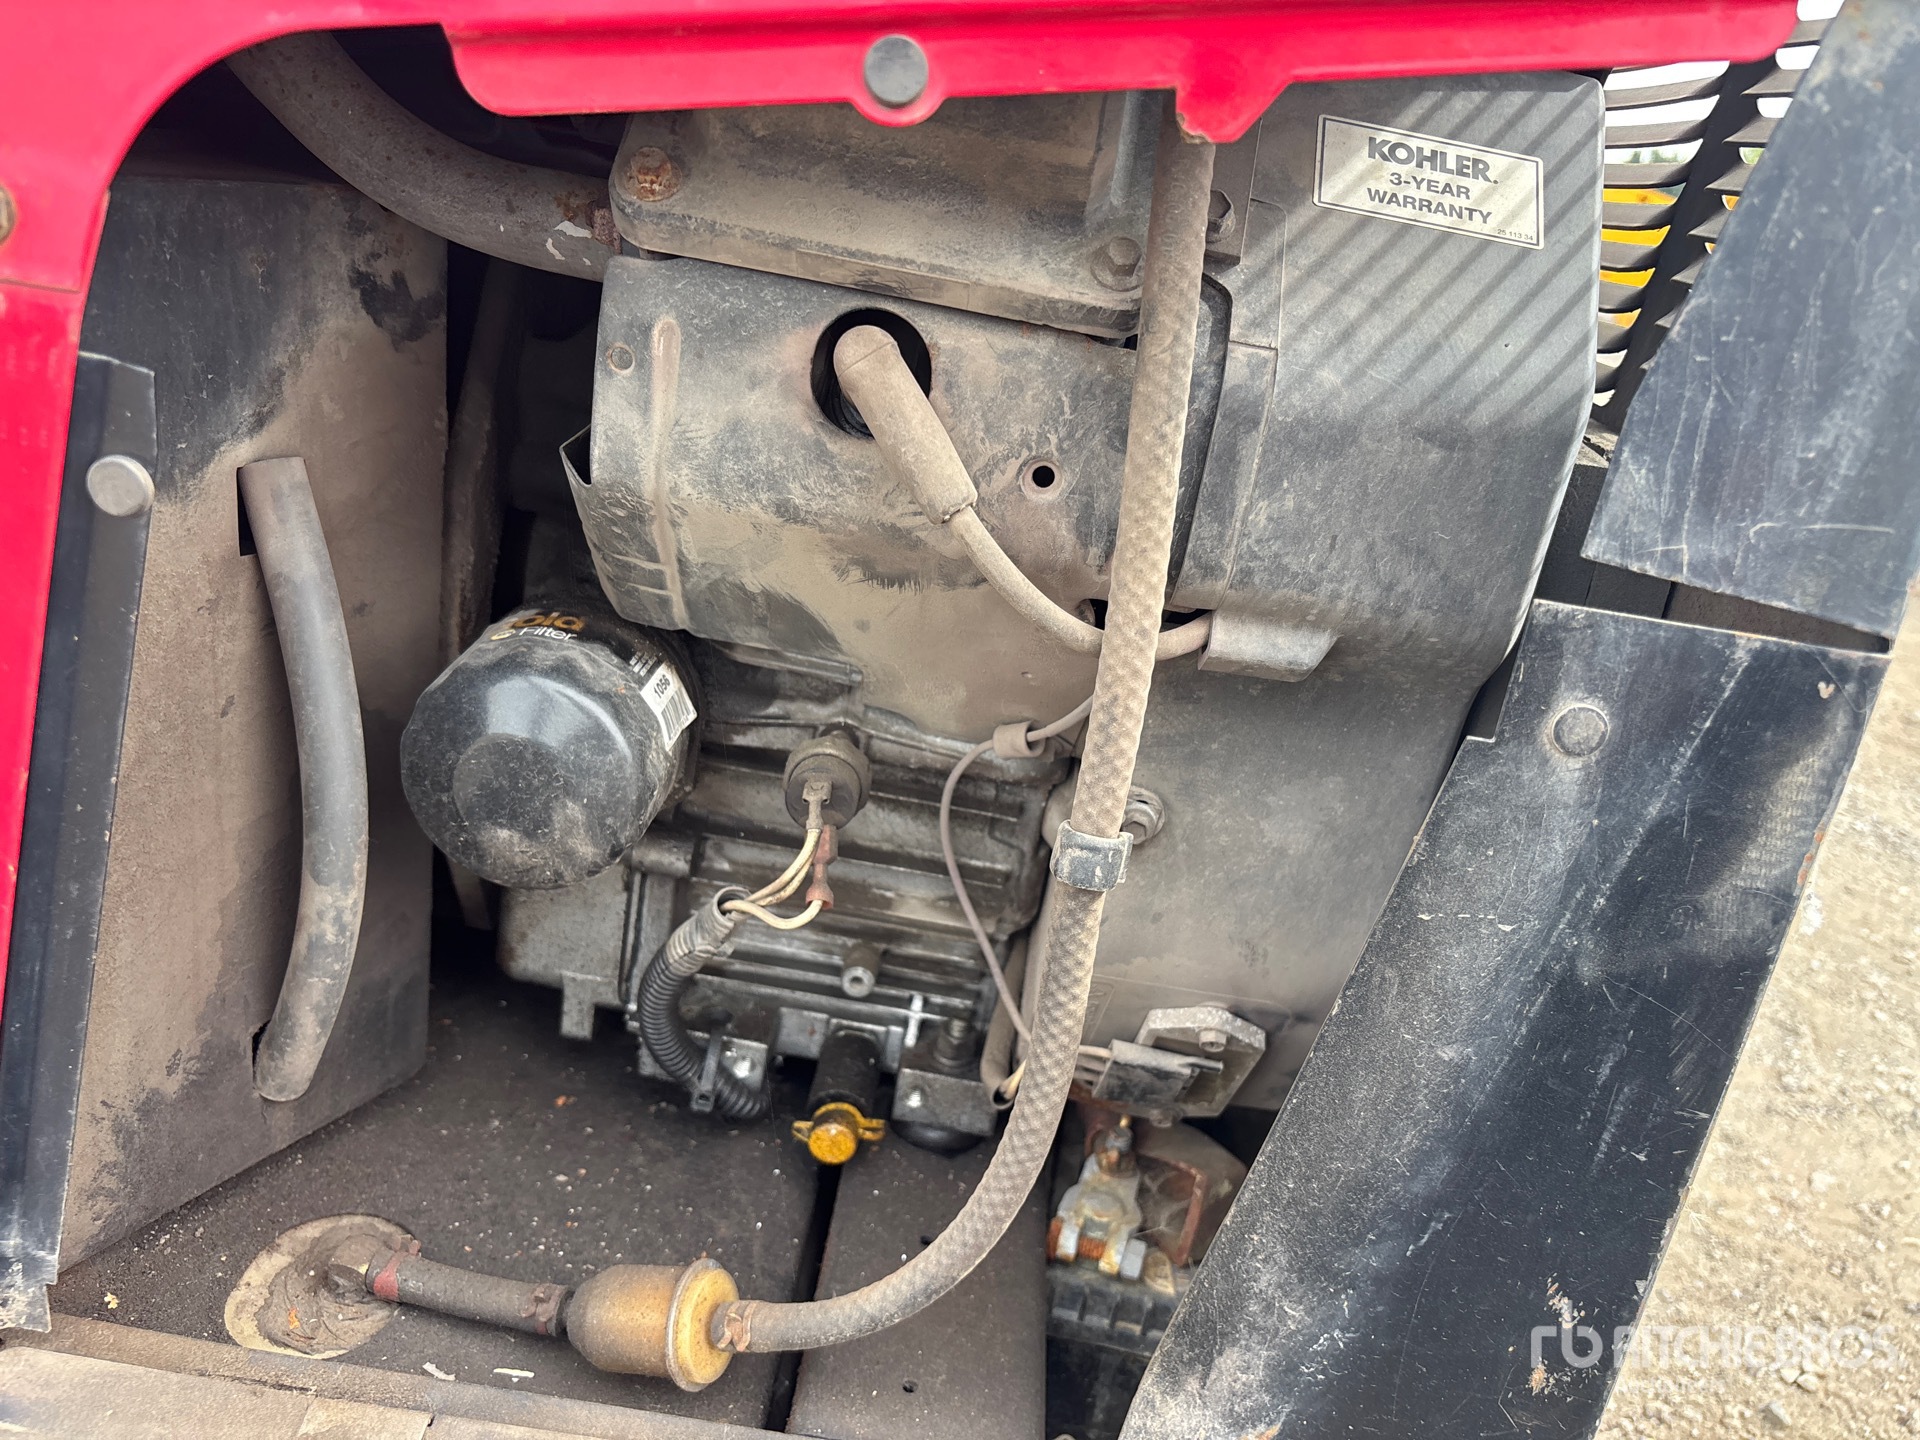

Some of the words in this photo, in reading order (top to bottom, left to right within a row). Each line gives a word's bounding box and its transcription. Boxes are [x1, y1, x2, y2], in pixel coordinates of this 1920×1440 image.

[1389, 172, 1471, 200] 3-YEAR
[1366, 188, 1493, 224] WARRANTY
[1509, 231, 1522, 239] 113
[518, 626, 578, 641] Filter
[653, 674, 671, 699] 1056
